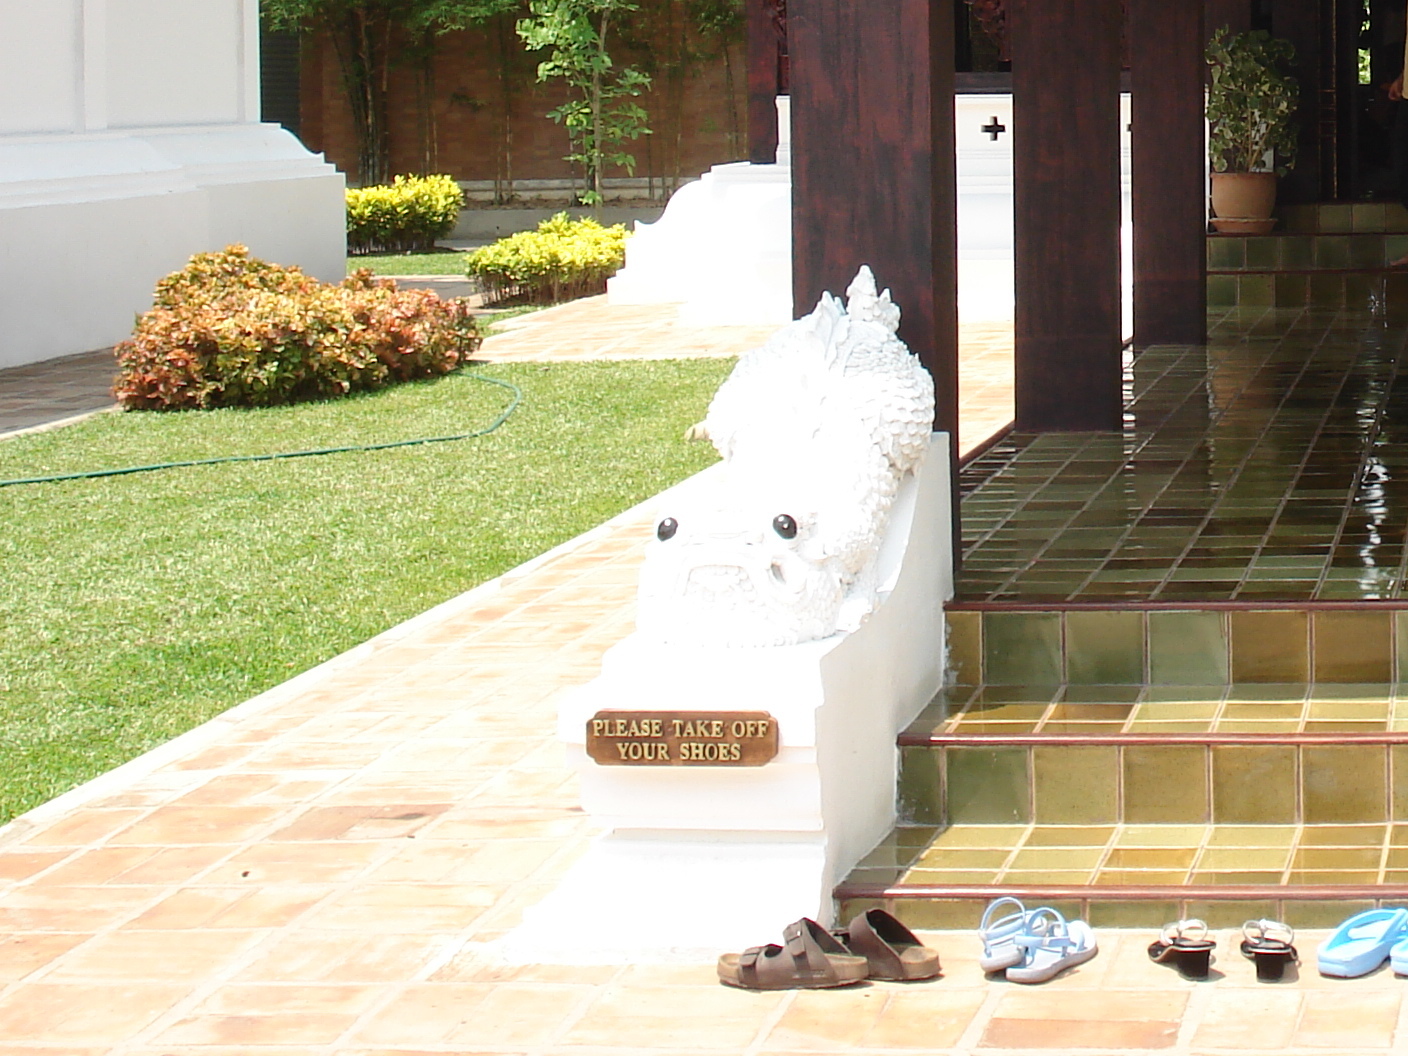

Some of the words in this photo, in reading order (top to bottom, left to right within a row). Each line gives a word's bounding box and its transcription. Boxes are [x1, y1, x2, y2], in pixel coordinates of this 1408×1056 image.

[592, 720, 662, 737] PLEASE
[672, 720, 723, 738] TAKE
[731, 721, 769, 738] OFF
[616, 743, 669, 760] YOUR
[679, 743, 741, 760] SHOES
